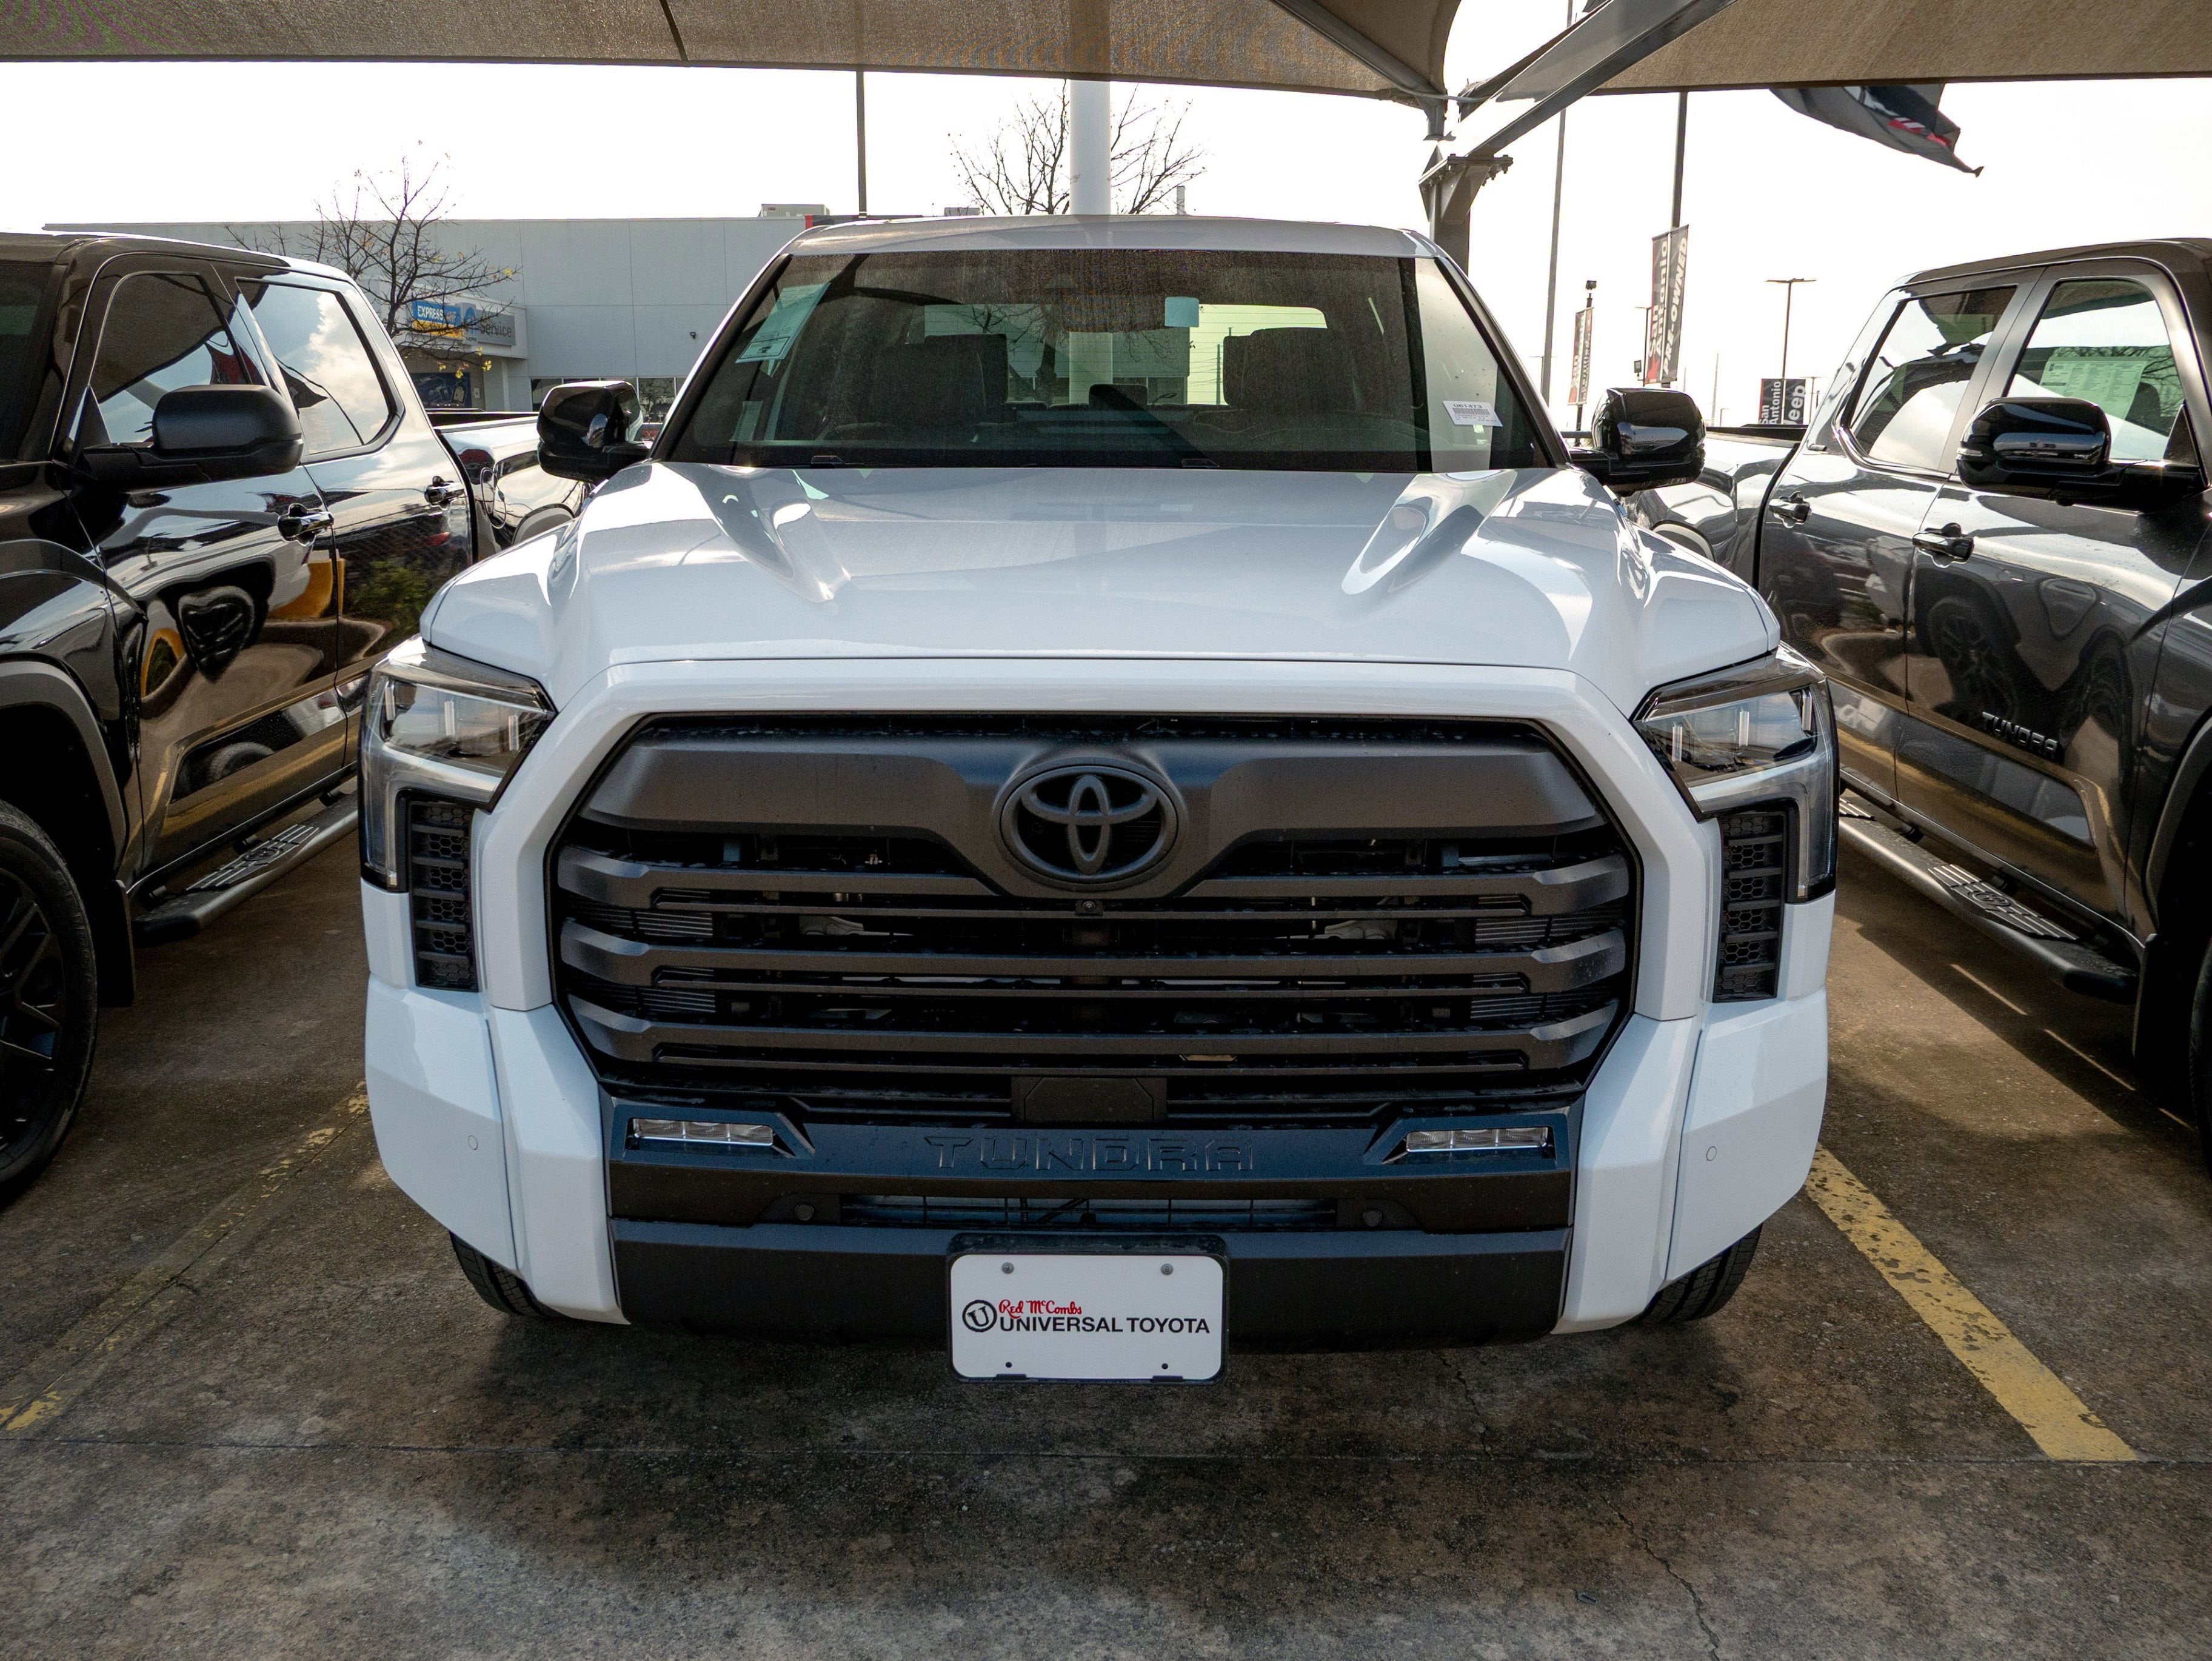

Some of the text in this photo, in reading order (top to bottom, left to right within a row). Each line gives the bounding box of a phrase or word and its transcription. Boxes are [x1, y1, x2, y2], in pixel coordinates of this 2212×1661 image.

[417, 305, 444, 321] EXPRESS
[1656, 241, 1668, 356] Antonio
[1663, 237, 1687, 375] PRE-OWNED
[1648, 304, 1659, 358] San
[1759, 404, 1769, 424] San
[1769, 381, 1782, 424] Antonio
[1982, 711, 2059, 758] TUNDRA
[924, 1135, 1253, 1171] TUNDRA
[998, 1299, 1083, 1319] Red McCombs
[1000, 1316, 1211, 1334] UNIVERSAL TOYOTA
